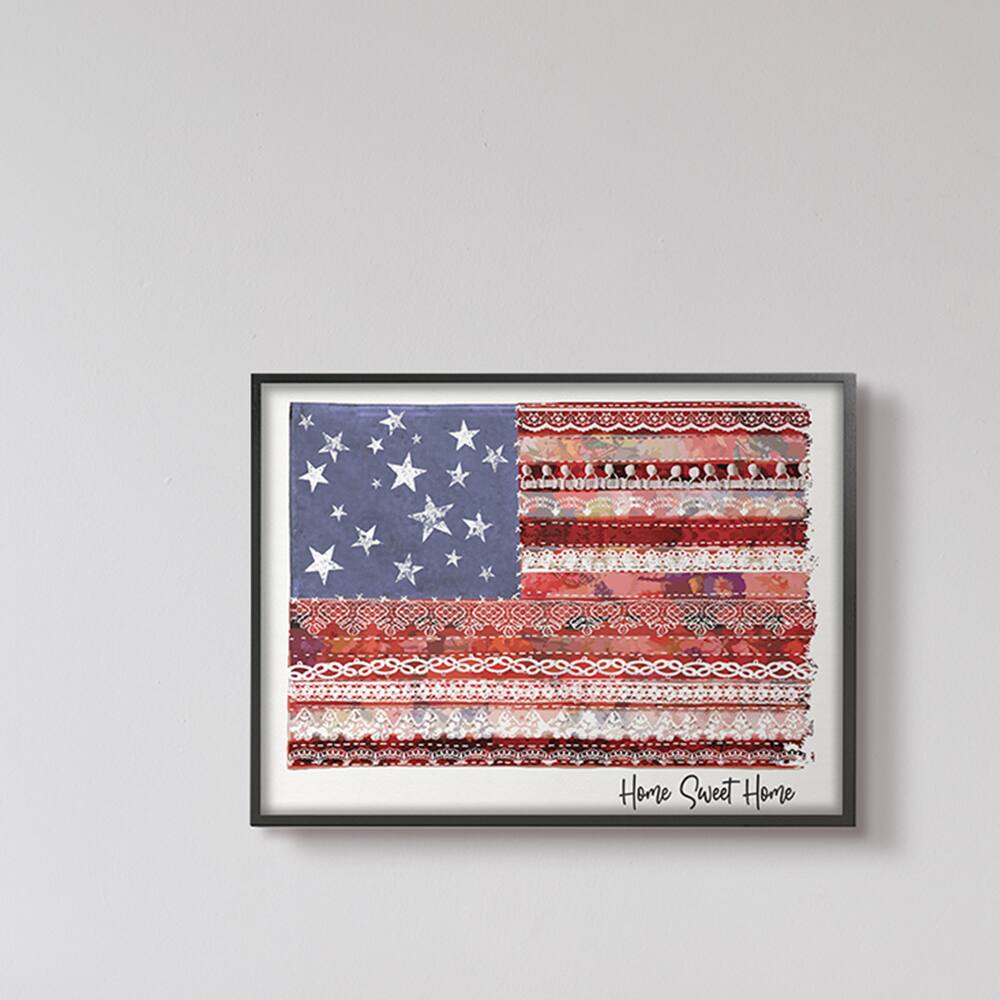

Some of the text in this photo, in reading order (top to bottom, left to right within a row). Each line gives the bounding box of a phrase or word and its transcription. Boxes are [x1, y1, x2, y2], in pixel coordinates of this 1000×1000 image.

[619, 774, 796, 811] Home Sweet Home
